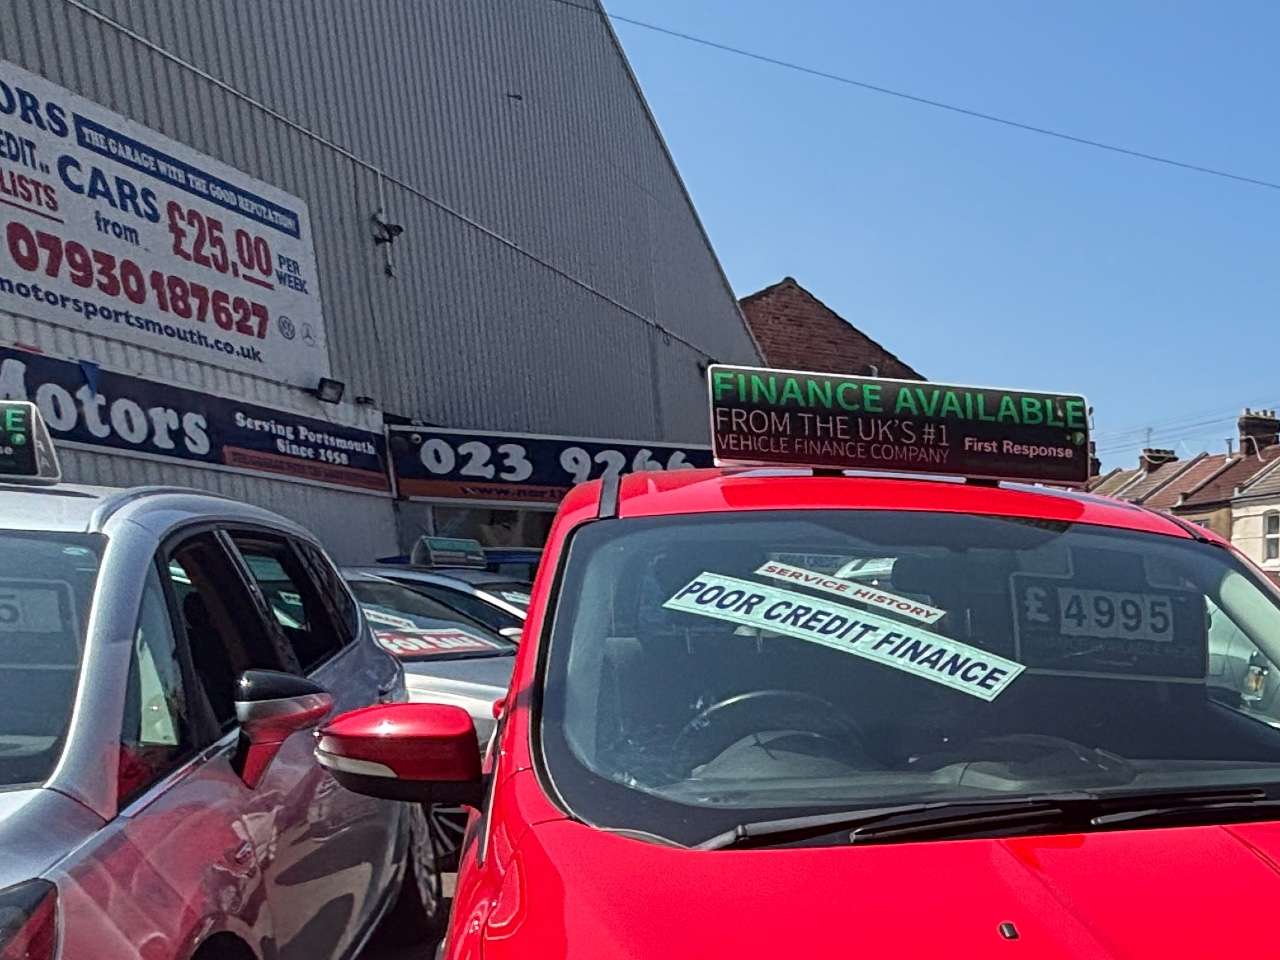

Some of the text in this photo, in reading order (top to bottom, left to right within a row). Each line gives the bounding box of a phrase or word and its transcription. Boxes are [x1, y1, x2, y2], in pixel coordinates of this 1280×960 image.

[82, 127, 109, 150] THE
[110, 136, 156, 171] GARAGE
[155, 157, 185, 184] WITH
[188, 173, 209, 195] THE
[57, 154, 161, 223] CARS
[95, 211, 140, 245] from
[167, 200, 273, 278] £25.00
[6, 221, 269, 339] 07930 187627
[275, 269, 308, 295] WEEK
[277, 253, 300, 276] PER
[713, 371, 1086, 429] FINANCE AVAILABLE
[235, 411, 376, 455] Serving Portsmouth
[276, 438, 315, 459] Since
[716, 408, 950, 447] FROM THE UK'S #1
[718, 433, 950, 465] VEHICLE FINANCE COMPANY
[964, 437, 1074, 459] First Response
[420, 438, 533, 482] 023
[765, 565, 938, 619] SERVICE HISTORY
[1064, 594, 1170, 634] 4995
[675, 581, 760, 615] POOR
[764, 601, 878, 644] CREDIT
[873, 632, 1007, 690] FINANCE
